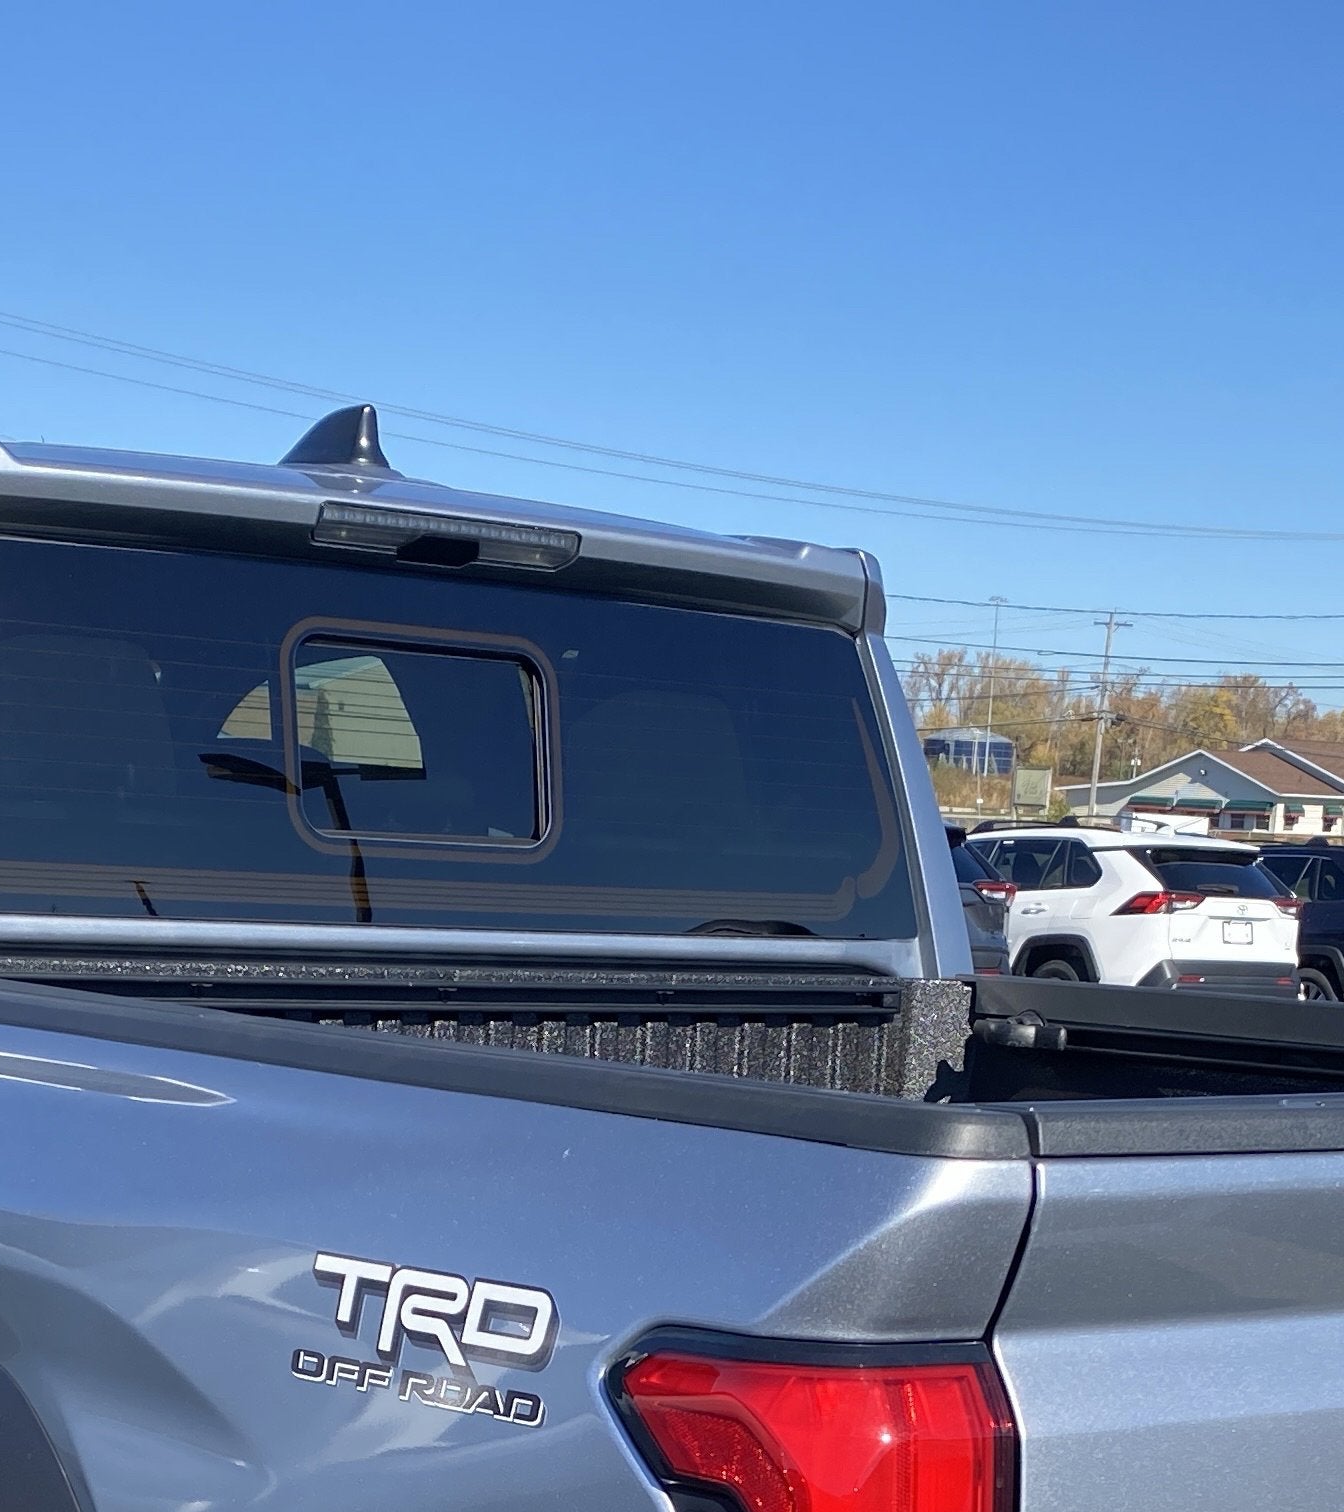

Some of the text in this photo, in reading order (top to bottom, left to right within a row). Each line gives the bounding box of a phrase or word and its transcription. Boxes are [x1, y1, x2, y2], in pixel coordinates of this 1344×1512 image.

[313, 1251, 562, 1386] TRD
[291, 1348, 546, 1428] OFF ROAD
